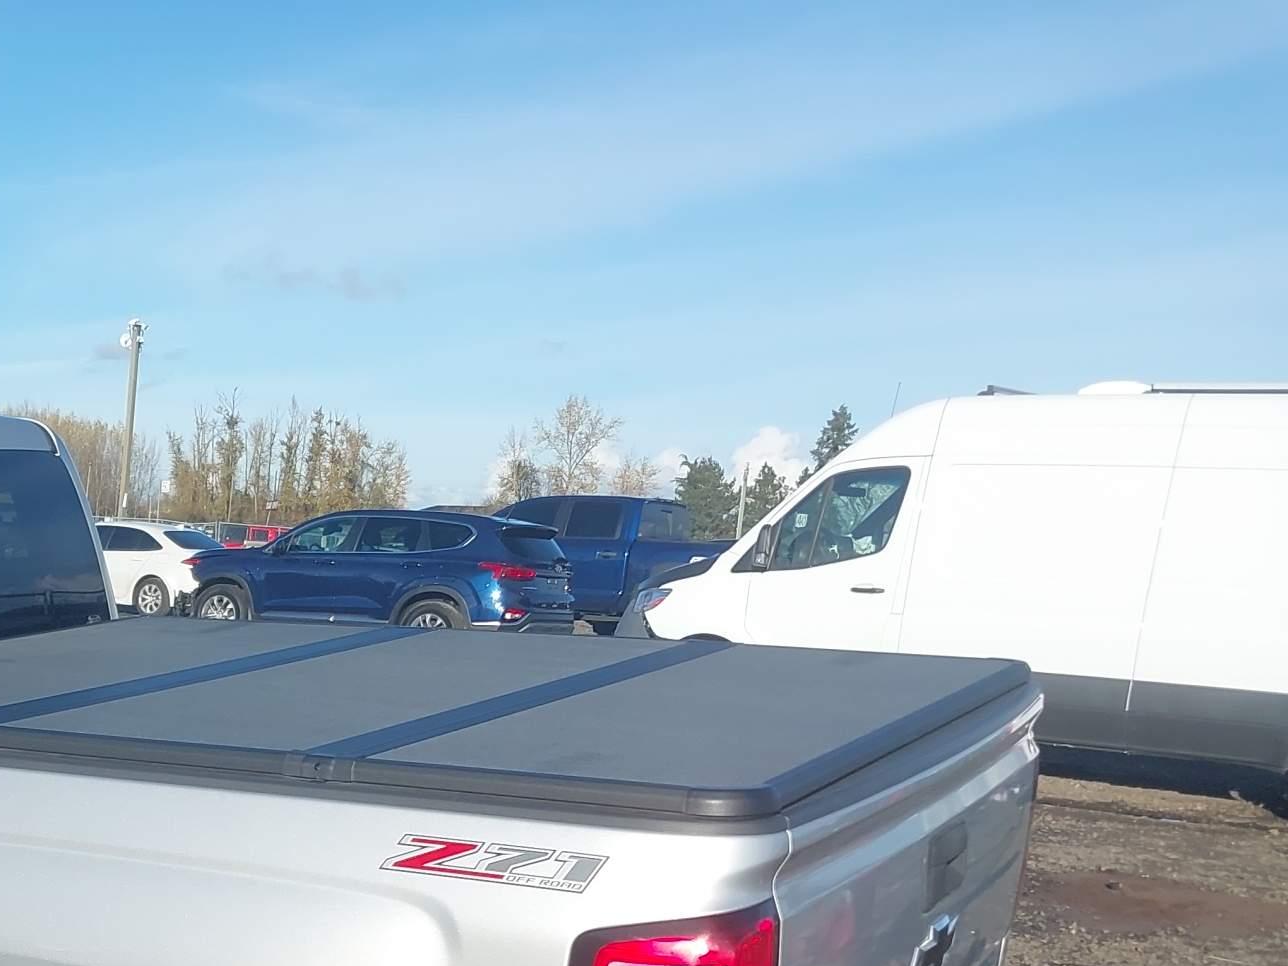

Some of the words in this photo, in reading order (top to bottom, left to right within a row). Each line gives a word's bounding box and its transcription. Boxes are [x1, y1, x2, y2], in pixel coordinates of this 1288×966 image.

[379, 833, 610, 894] Z71
[505, 874, 536, 885] OFF
[539, 878, 583, 891] ROAD
